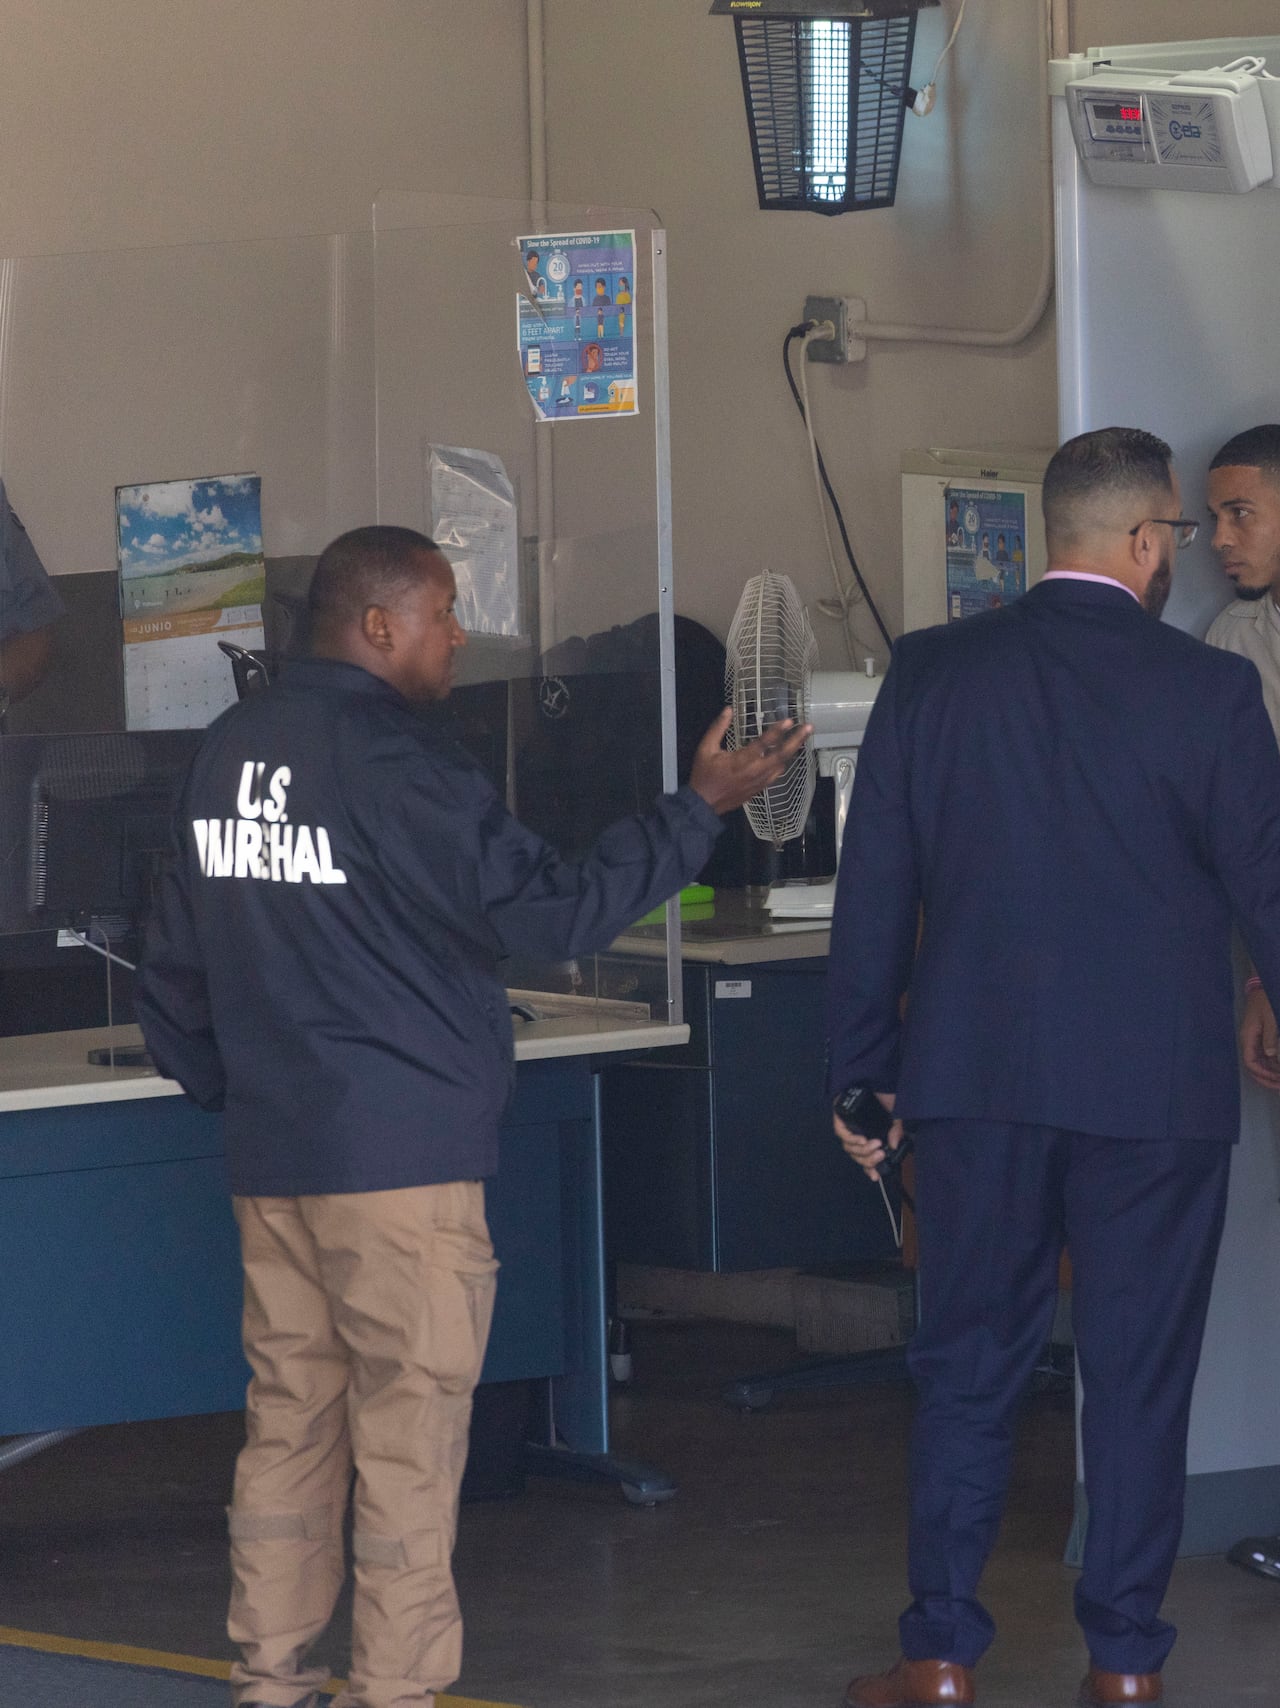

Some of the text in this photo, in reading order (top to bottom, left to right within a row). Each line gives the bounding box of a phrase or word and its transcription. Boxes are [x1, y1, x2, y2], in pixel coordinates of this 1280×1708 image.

[540, 240, 549, 248] the
[550, 239, 569, 248] Spread
[575, 237, 600, 245] COVID-19
[138, 621, 172, 634] JUNIO
